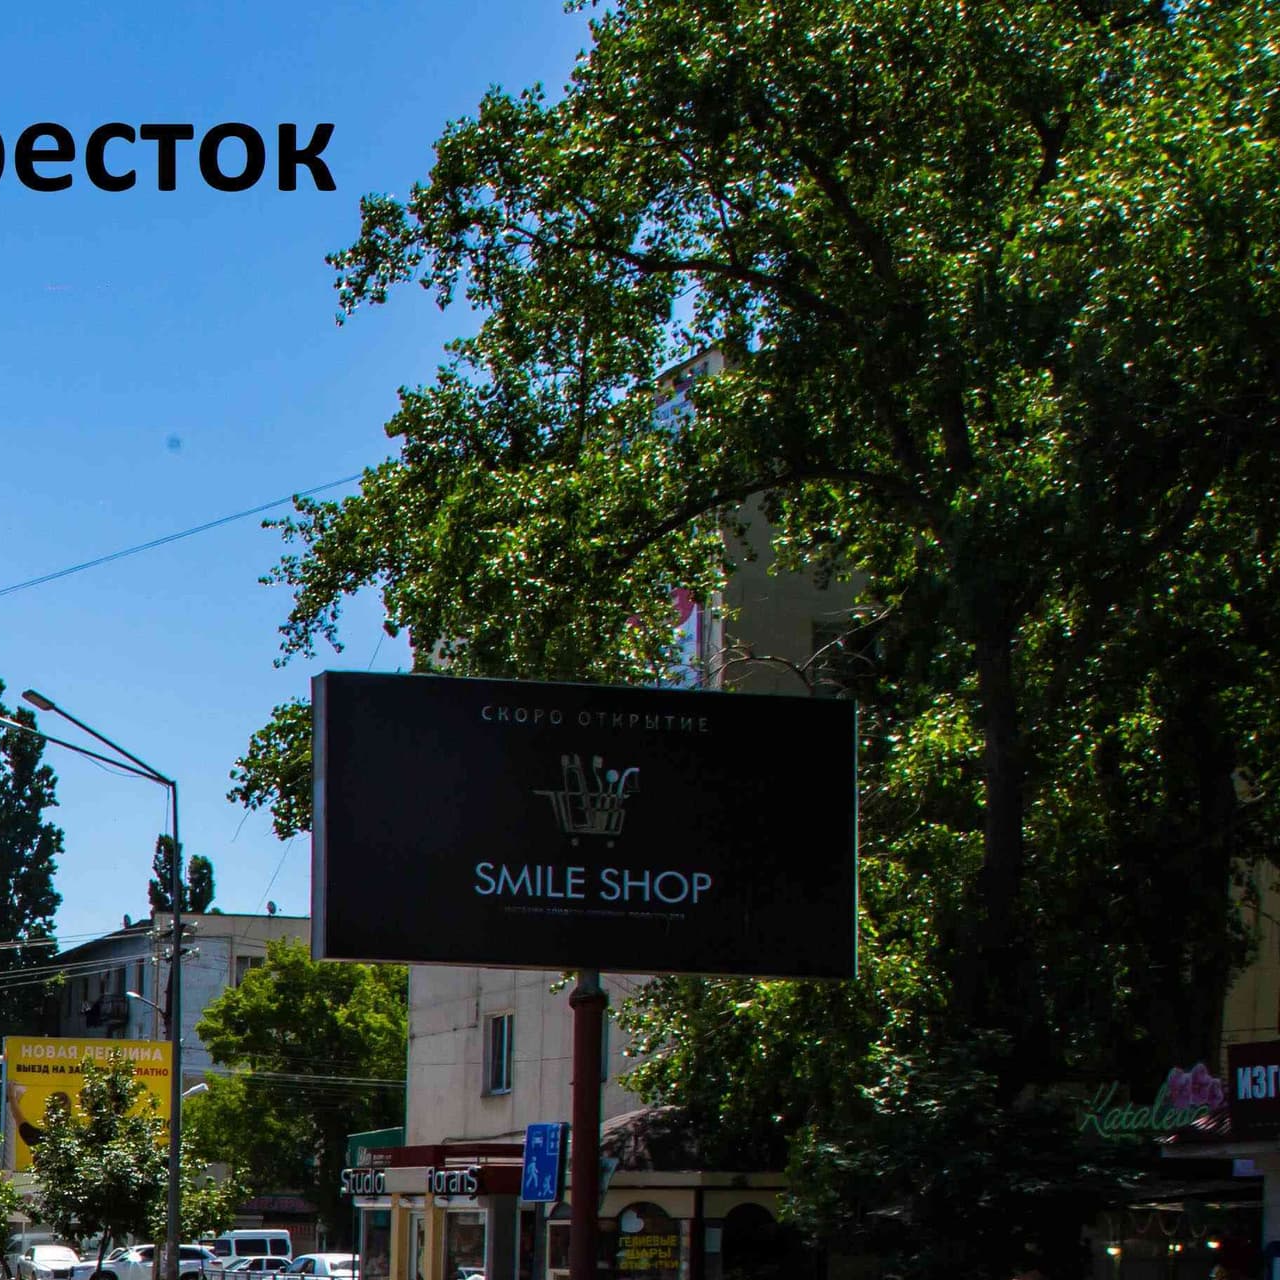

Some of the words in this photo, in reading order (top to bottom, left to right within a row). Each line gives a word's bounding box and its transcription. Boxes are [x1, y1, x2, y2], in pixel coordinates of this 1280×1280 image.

[481, 706, 563, 725] СКОРО
[578, 711, 709, 732] ОТКРЫТИЕ
[474, 861, 585, 898] SMILE
[599, 867, 712, 904] SHOP
[21, 1044, 78, 1060] НОВАЯ
[16, 1064, 50, 1075] ВЫЕЗД
[52, 1065, 66, 1075] НА
[1237, 1065, 1280, 1100] ИЗГ
